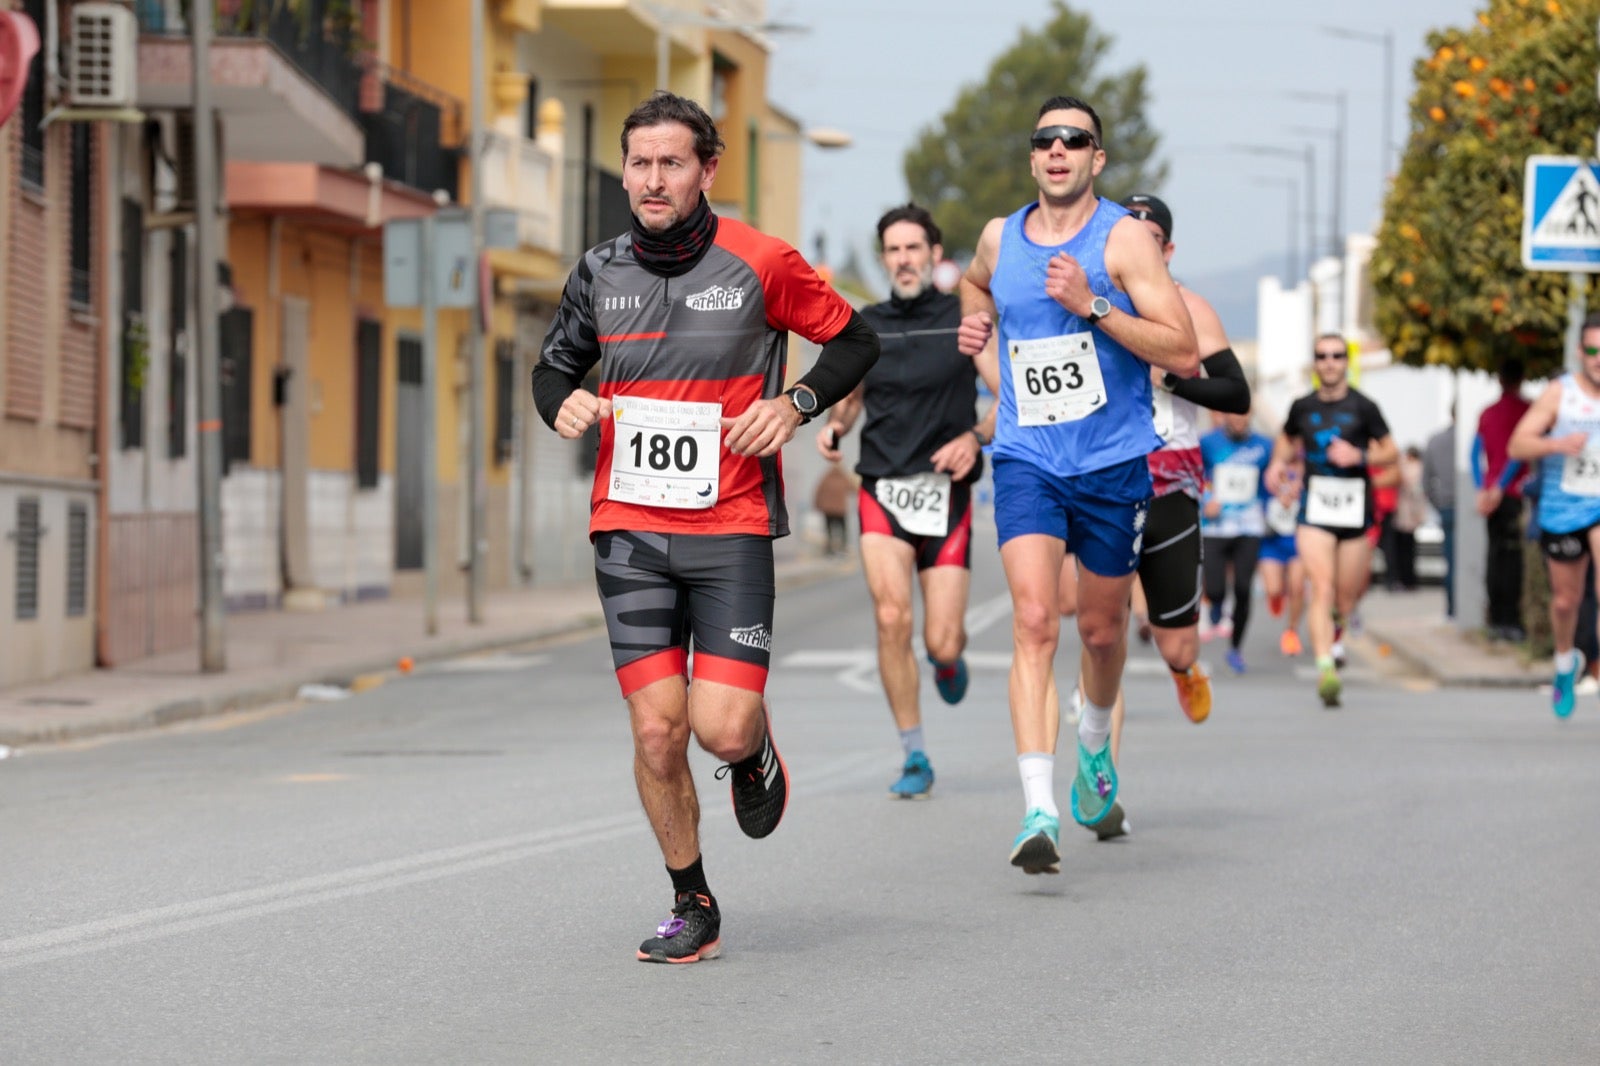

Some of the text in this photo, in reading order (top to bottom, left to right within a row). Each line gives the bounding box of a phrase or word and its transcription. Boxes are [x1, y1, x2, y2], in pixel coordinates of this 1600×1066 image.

[605, 295, 641, 310] GOBIK
[692, 289, 741, 308] ATARFE
[1026, 362, 1084, 396] 663
[630, 431, 698, 472] 180
[885, 483, 942, 511] 3062
